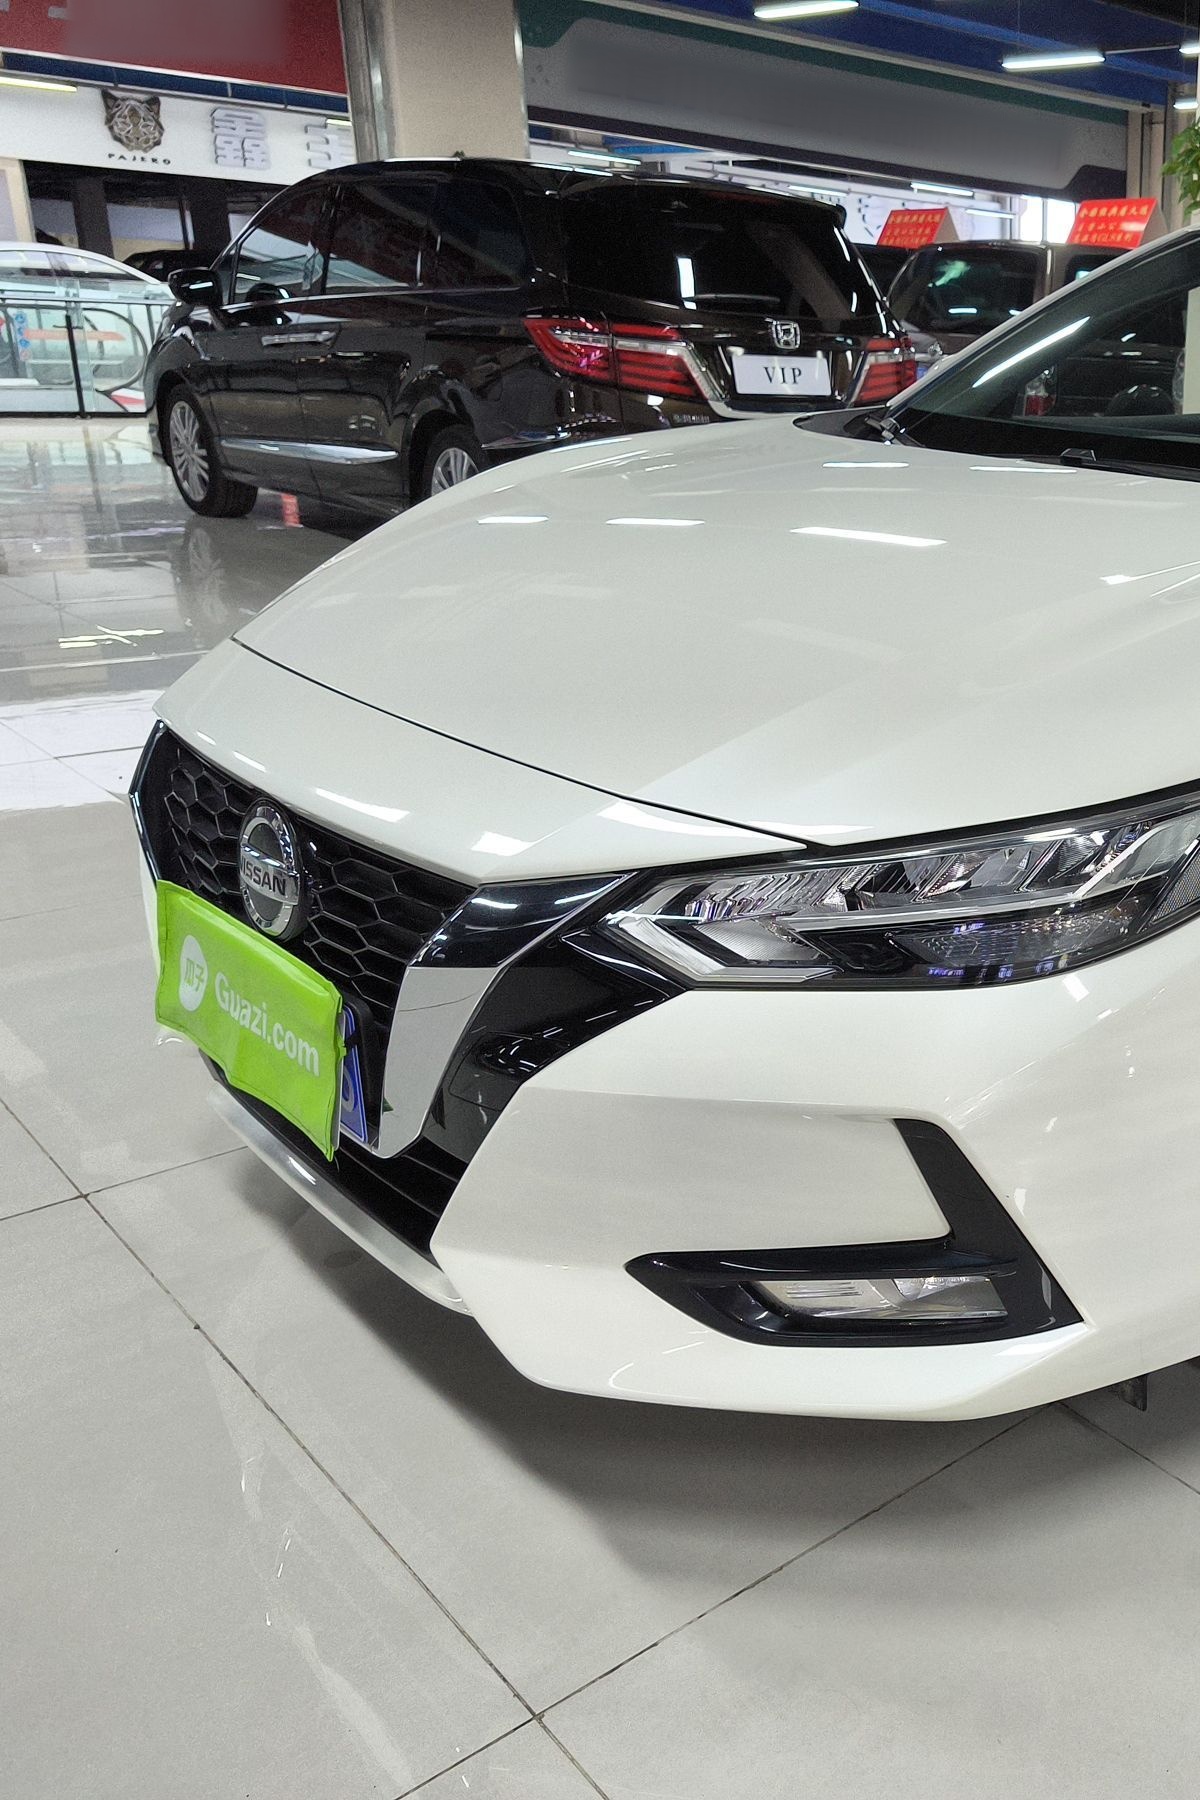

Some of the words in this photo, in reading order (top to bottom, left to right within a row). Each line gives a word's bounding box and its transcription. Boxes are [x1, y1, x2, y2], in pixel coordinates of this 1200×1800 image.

[107, 153, 171, 166] PAJERO
[763, 366, 802, 385] VIP
[184, 957, 206, 992] 瓜子
[214, 971, 320, 1077] Guazi.com
